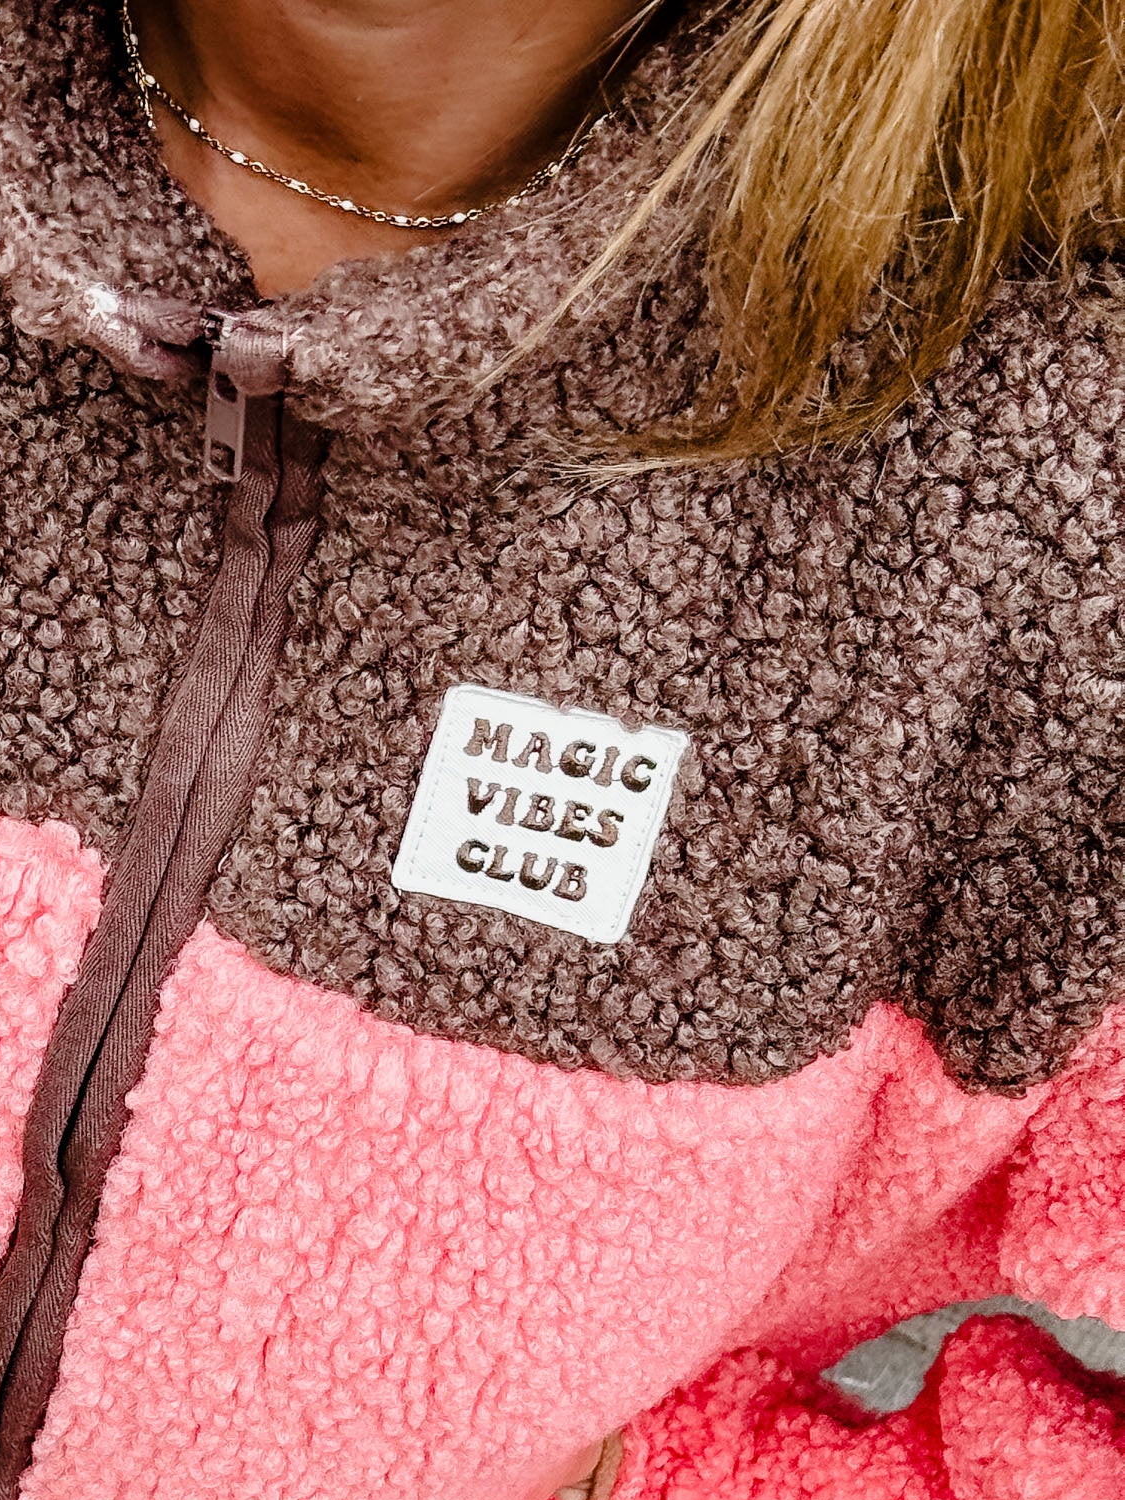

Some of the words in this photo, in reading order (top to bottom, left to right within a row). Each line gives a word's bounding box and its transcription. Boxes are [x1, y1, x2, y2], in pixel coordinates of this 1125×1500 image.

[463, 718, 658, 793] MAGIC
[466, 777, 625, 848] VIBES
[456, 838, 588, 902] CLUB
